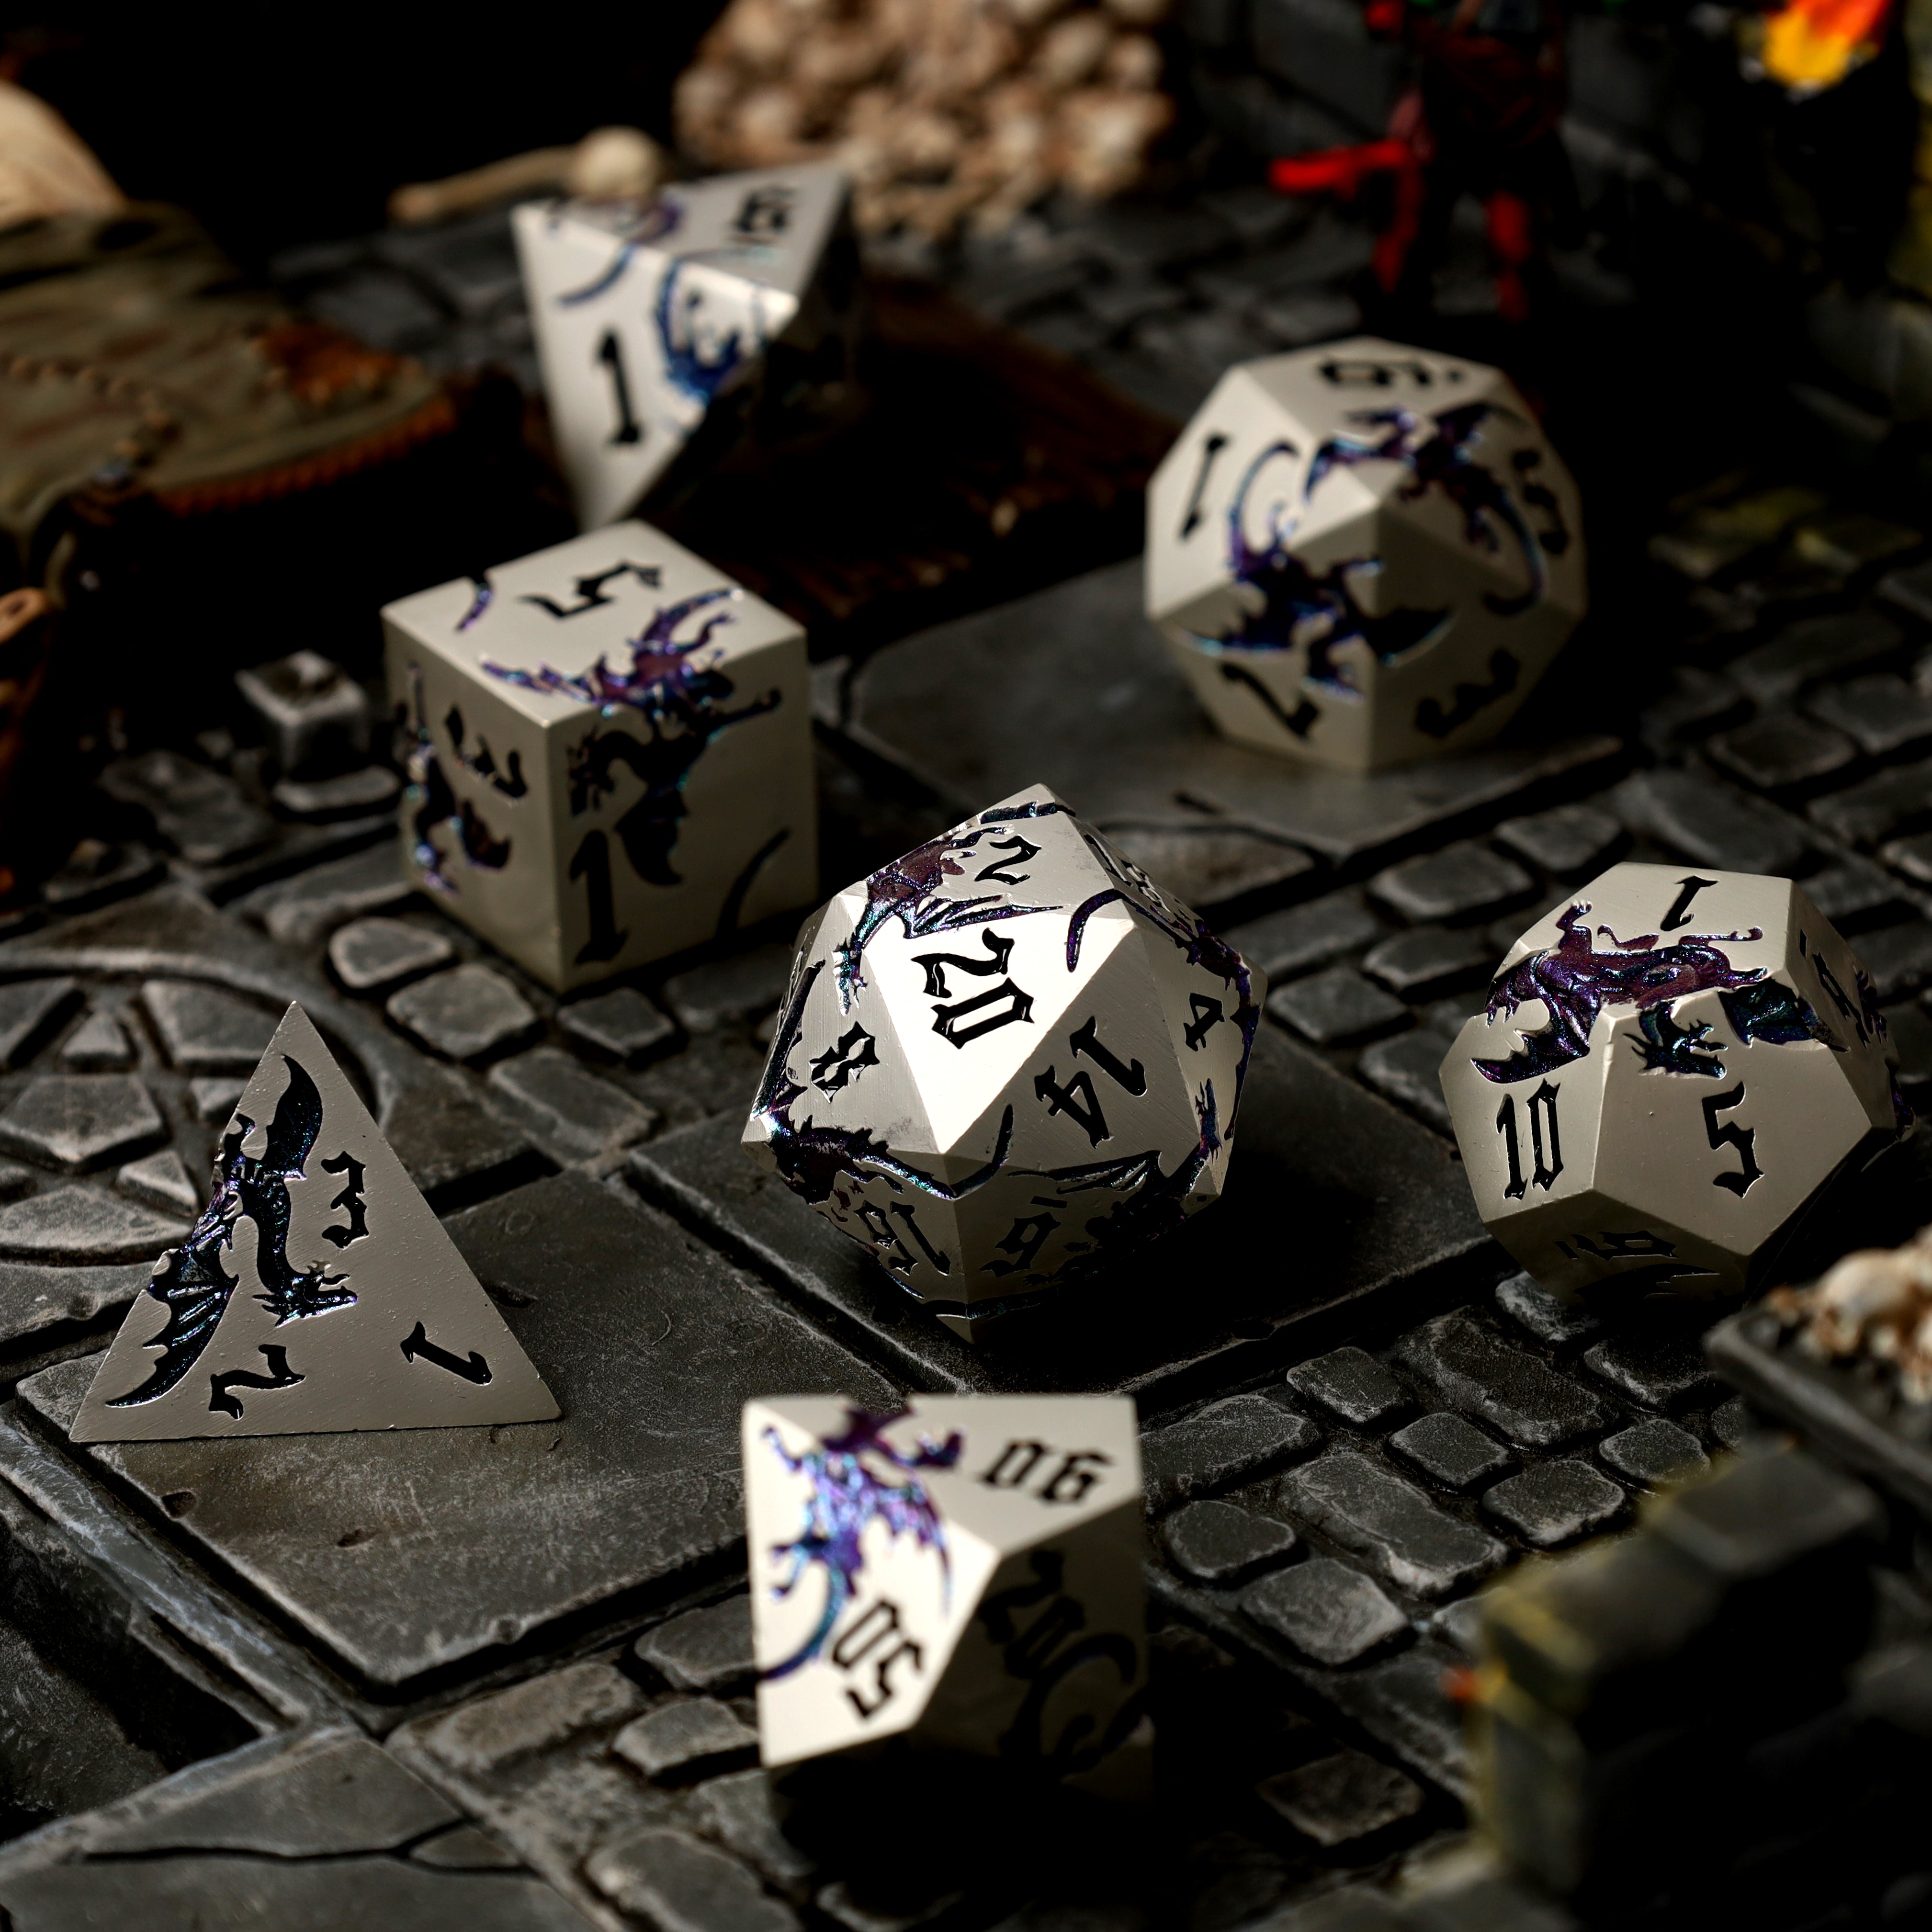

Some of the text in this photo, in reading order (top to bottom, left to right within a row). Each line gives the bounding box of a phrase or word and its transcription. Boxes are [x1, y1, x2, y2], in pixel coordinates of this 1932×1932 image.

[596, 327, 643, 446] 1
[1179, 435, 1230, 540] 1
[1512, 450, 1568, 554] 5
[522, 562, 663, 618] 5
[1416, 647, 1519, 738] 3
[445, 705, 527, 797] 3
[570, 829, 629, 963] 1
[975, 836, 1041, 885] 2
[1661, 876, 1719, 931] 1
[912, 927, 1034, 1049] 20
[1184, 993, 1224, 1051] 4
[809, 1022, 880, 1102] 8
[1035, 1016, 1148, 1148] 14
[1496, 1079, 1564, 1199] 10
[1702, 1081, 1764, 1198] 5
[322, 1152, 369, 1248] 3
[209, 1344, 305, 1419] 2
[401, 1321, 493, 1385] 1
[833, 1600, 923, 1718] 50
[978, 1550, 1085, 1679] 20
